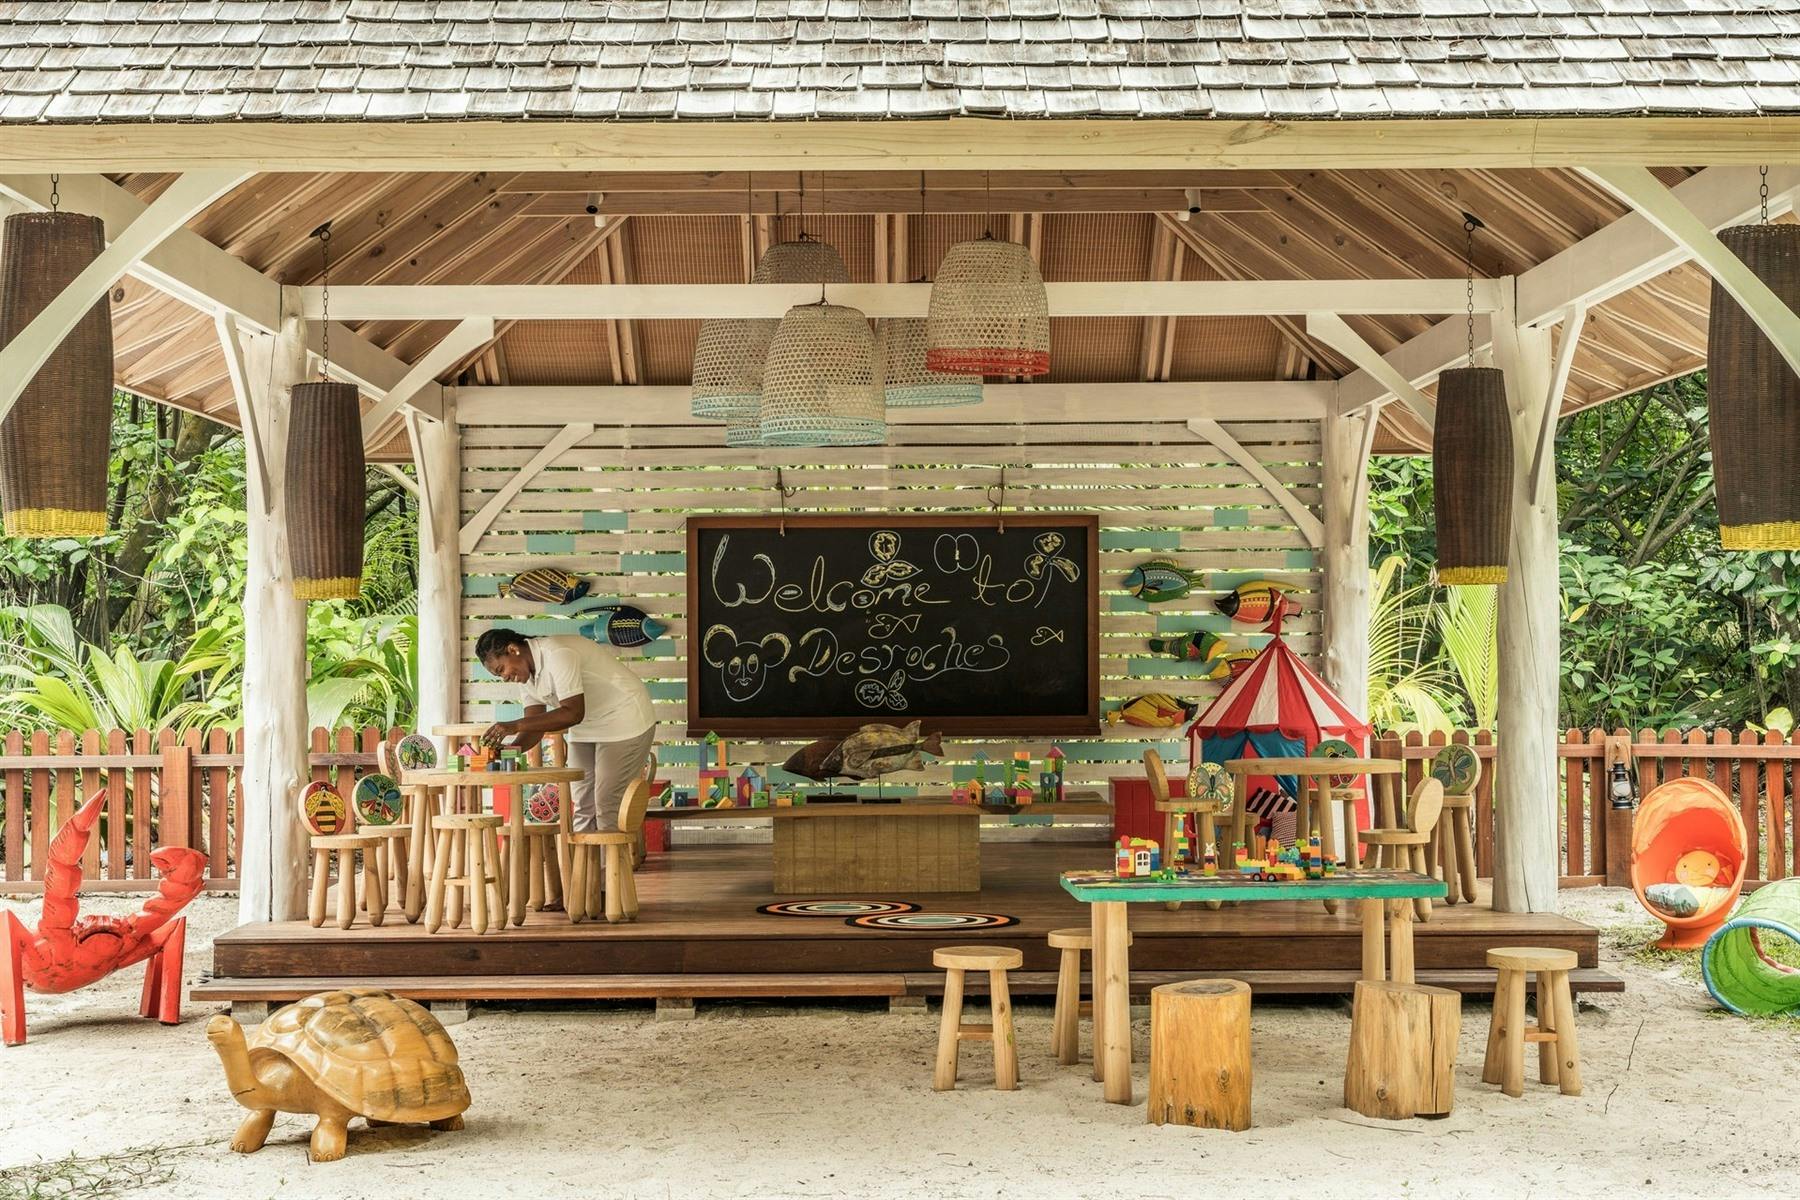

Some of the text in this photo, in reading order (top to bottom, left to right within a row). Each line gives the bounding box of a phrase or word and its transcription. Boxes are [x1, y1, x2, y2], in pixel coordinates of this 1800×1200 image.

[712, 534, 1035, 612] Welcome to
[788, 627, 1011, 682] Desroches
